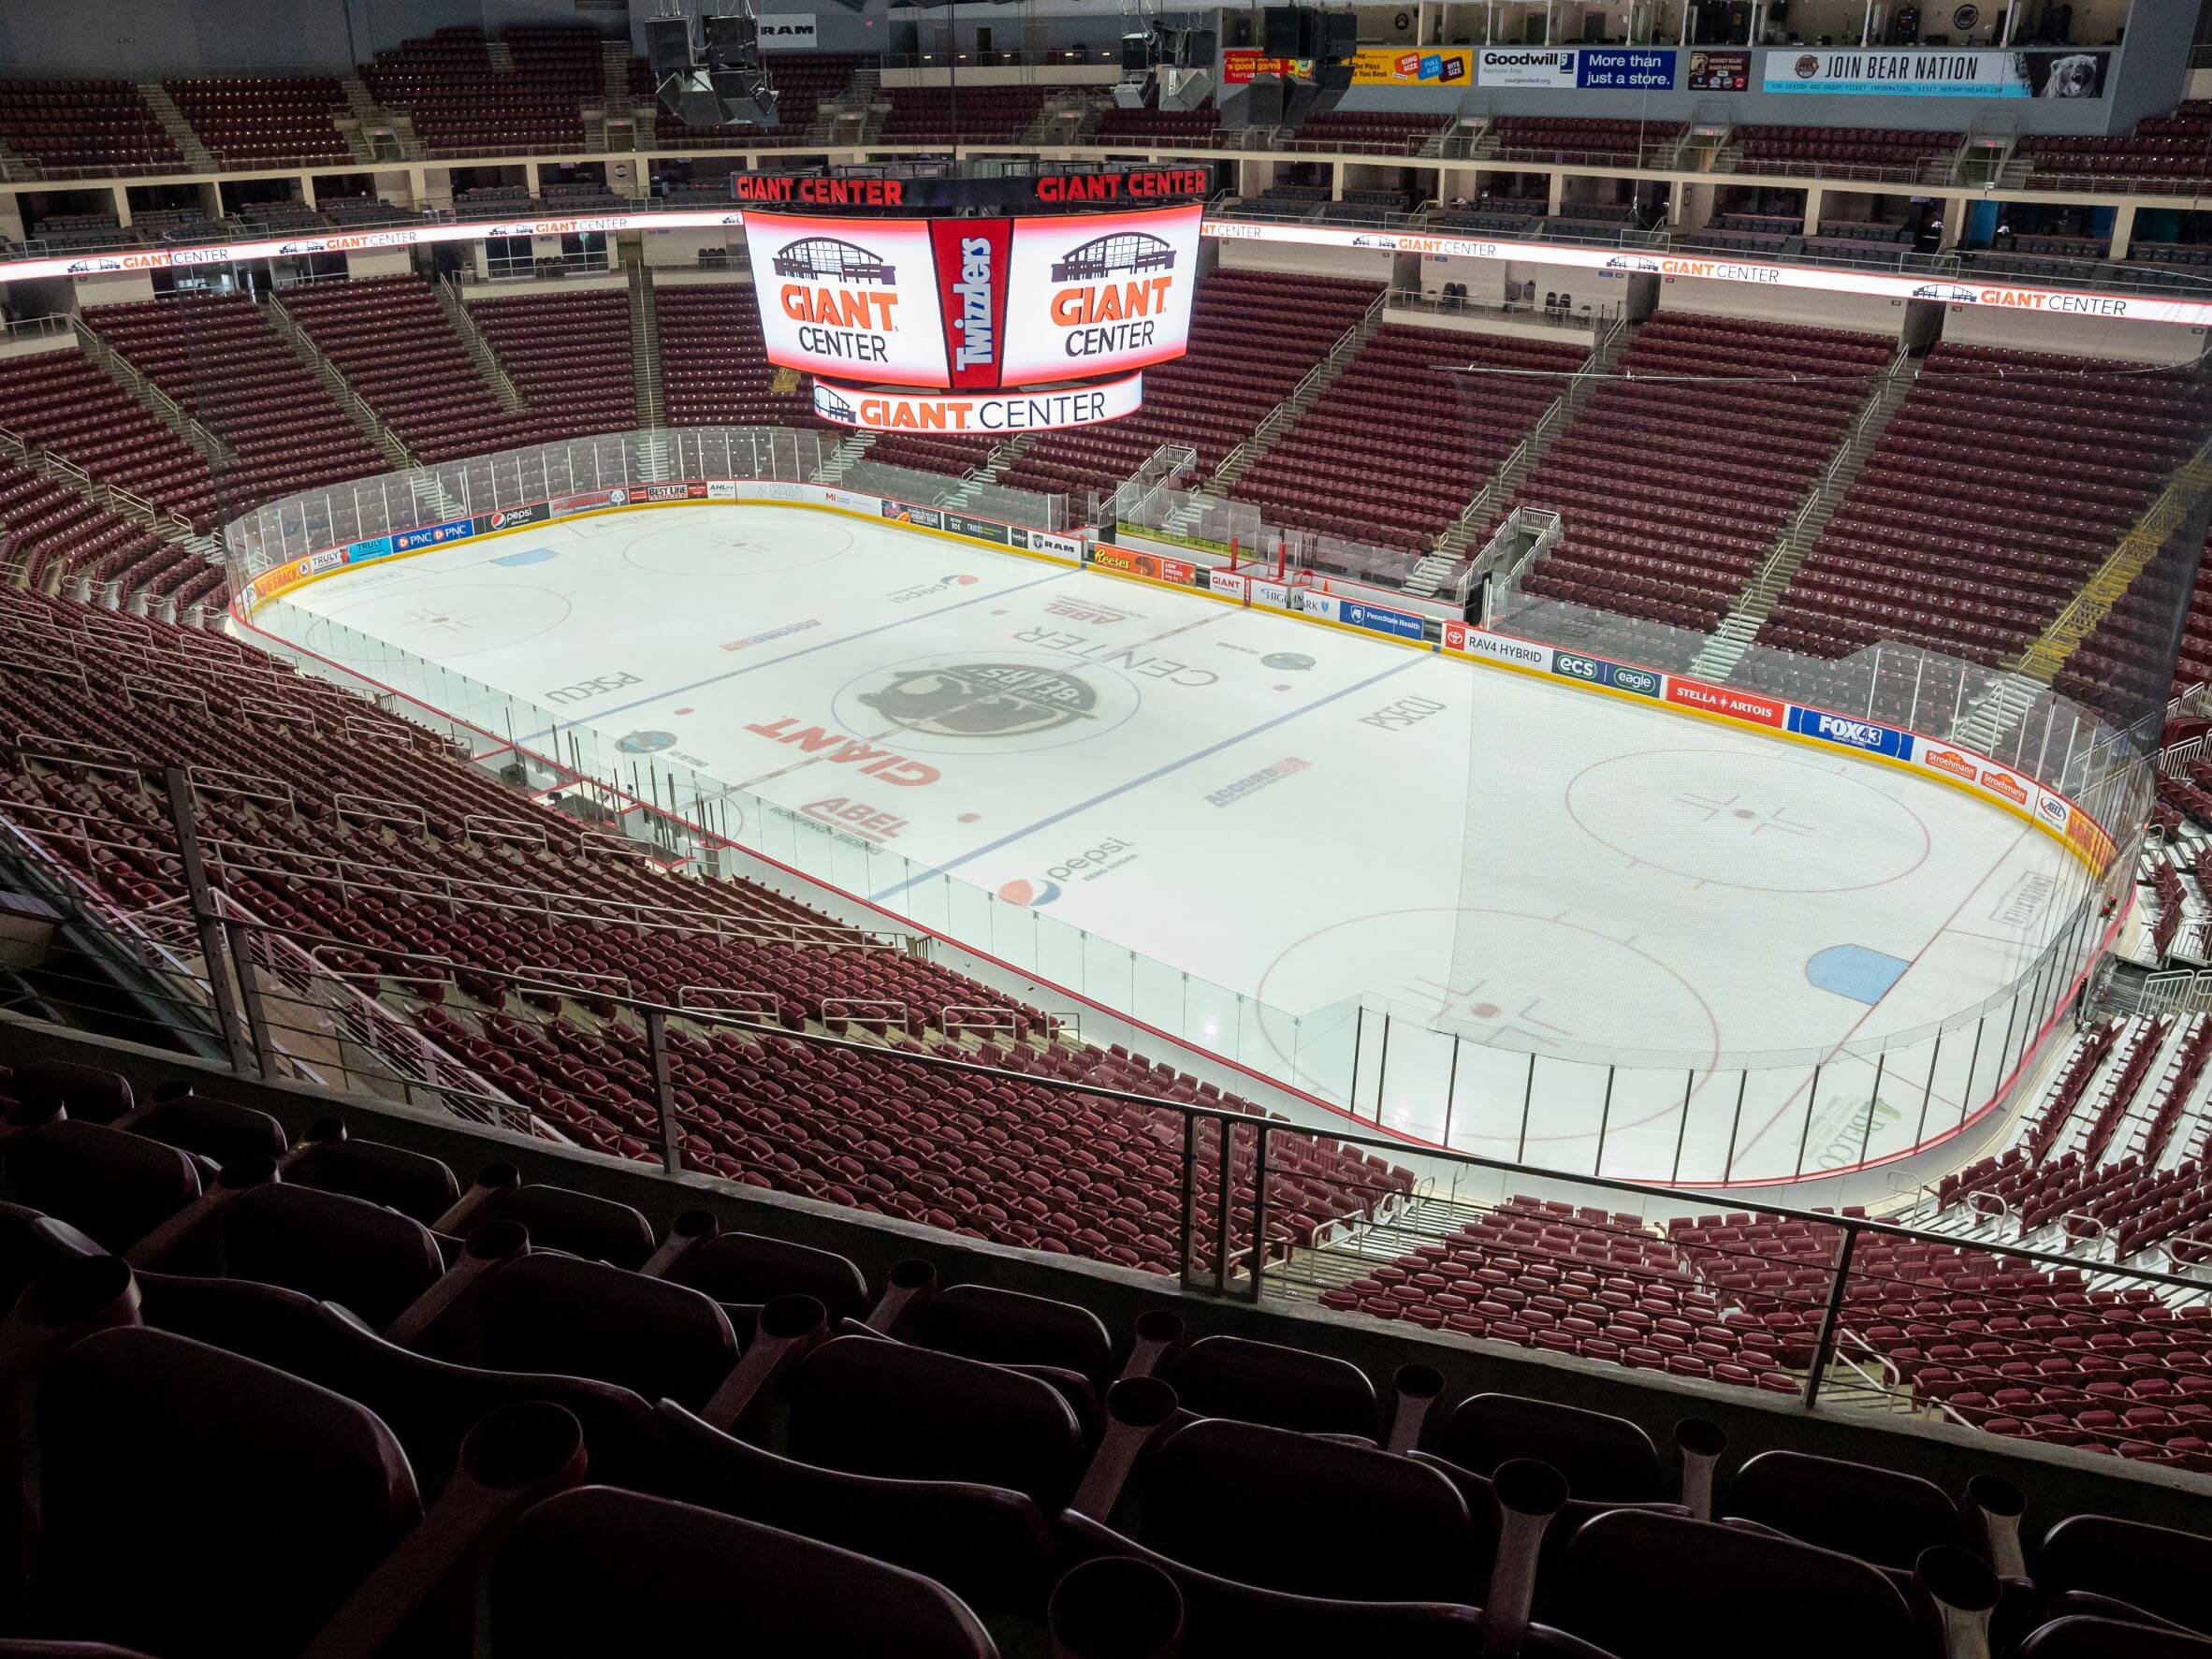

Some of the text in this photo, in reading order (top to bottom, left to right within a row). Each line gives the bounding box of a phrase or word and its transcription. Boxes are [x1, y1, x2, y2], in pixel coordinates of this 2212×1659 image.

[761, 25, 814, 35] RAM
[1402, 55, 1418, 65] KING
[1404, 63, 1419, 72] SIZE
[1426, 65, 1439, 74] SIZE
[1448, 61, 1460, 69] BITE
[1484, 52, 1558, 65] Goodwill
[1589, 54, 1662, 67] More than
[1825, 56, 1978, 80] JOIN BEAR NATION
[1448, 67, 1461, 76] SIZE
[1587, 72, 1670, 85] just a store.
[737, 176, 902, 204] GIANT CENTER
[1038, 170, 1206, 202] GIANT CENTER
[535, 218, 627, 233] GIANT CENTER
[1217, 226, 1261, 239] CENTER
[327, 231, 417, 250] GIANT CENTER
[1398, 239, 1496, 257] GIANT CENTER
[123, 249, 228, 269] GIANT CENTER
[1663, 260, 1779, 284] GIANT CENTER
[780, 284, 897, 331] GIANT
[956, 237, 993, 371] Twizzlers
[1051, 276, 1171, 327] GIANT
[1981, 290, 2127, 316] GIANT CENTER
[799, 326, 889, 363] CENTER
[1066, 321, 1154, 357] CENTER
[861, 391, 1105, 429] GIANT CENTER
[649, 487, 670, 496] BEST
[670, 486, 687, 495] LINE
[506, 507, 531, 523] pepsi
[410, 531, 431, 545] PNC
[445, 525, 466, 537] PNC
[357, 538, 383, 550] TRULY
[1044, 541, 1075, 553] RAM
[313, 551, 339, 566] TRULY
[1095, 549, 1130, 569] Reese's
[890, 581, 947, 604] pepsi
[1212, 576, 1240, 589] GIANT
[1043, 601, 1127, 625] ABEL
[1367, 612, 1420, 630] PennState Health
[1013, 627, 1219, 686] CENTER
[1469, 638, 1542, 663] RAV4 HYBRID
[1560, 655, 1594, 677] ecs
[545, 671, 644, 704] PSECU
[976, 667, 1080, 703] BEARS
[1618, 671, 1652, 691] eagle
[1358, 693, 1448, 731] PSECU
[1677, 687, 1772, 719] STELLA ARTOIS
[742, 717, 940, 786] GIANT
[1929, 752, 1974, 776] Stroehmann
[1984, 774, 2025, 798] Stroehmann
[800, 797, 910, 840] ABEL
[2045, 802, 2062, 818] AHL
[768, 807, 883, 855] ROOFING SIDING
[1047, 837, 1133, 882] pepsi
[1083, 854, 1139, 881] ZERO SUGAR
